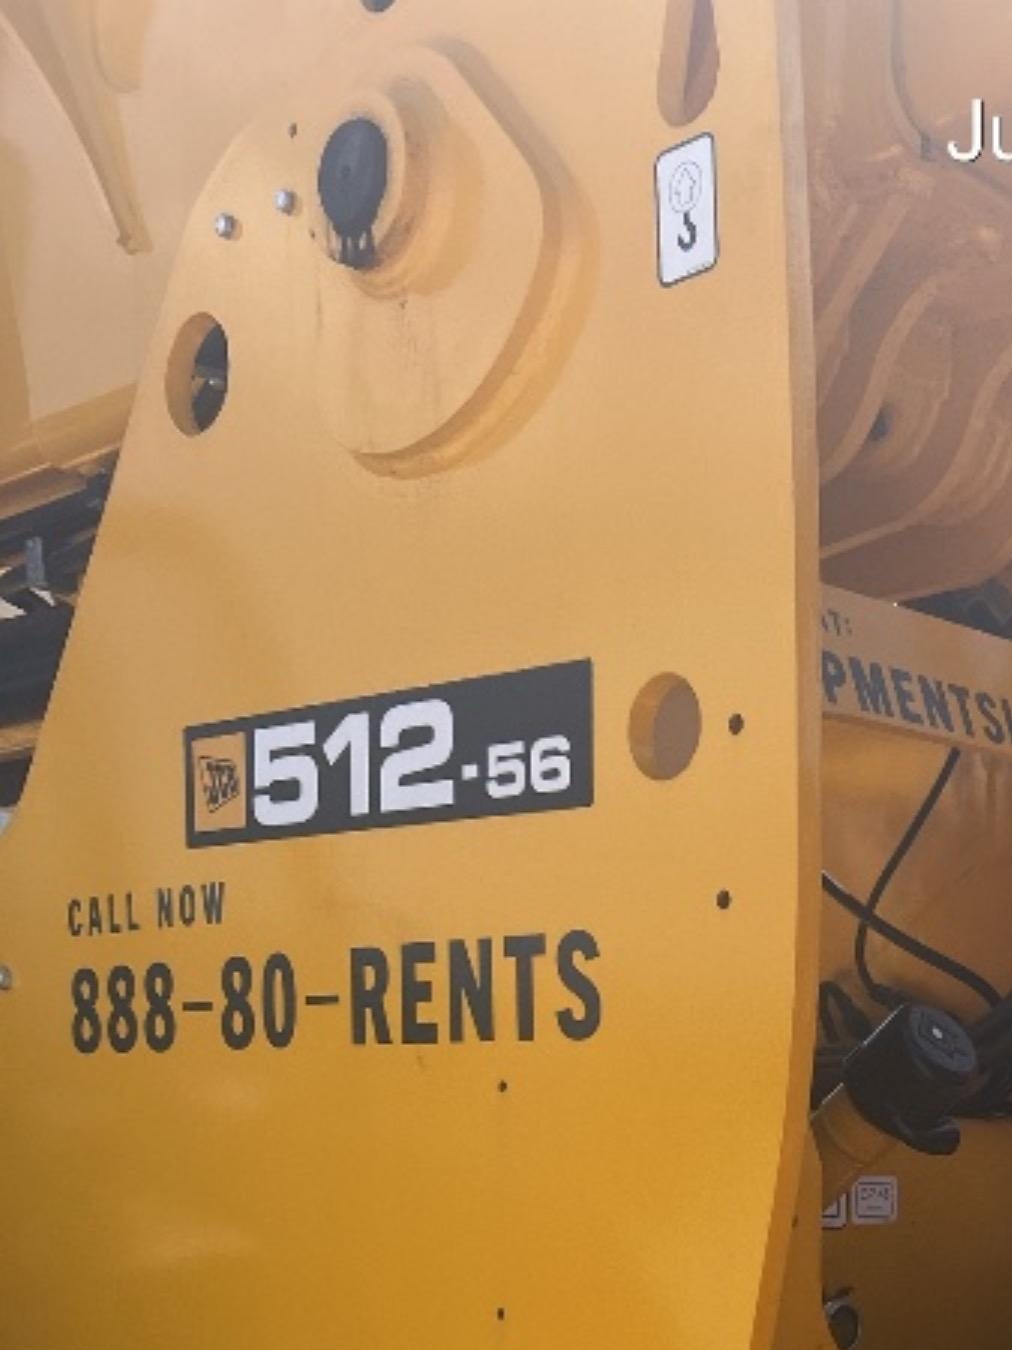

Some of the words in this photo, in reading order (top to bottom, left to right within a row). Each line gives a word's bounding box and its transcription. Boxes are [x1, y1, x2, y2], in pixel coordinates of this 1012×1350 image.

[67, 890, 141, 937] CALL
[156, 882, 226, 929] NOW
[70, 928, 603, 1054] 888-80-RENTS
